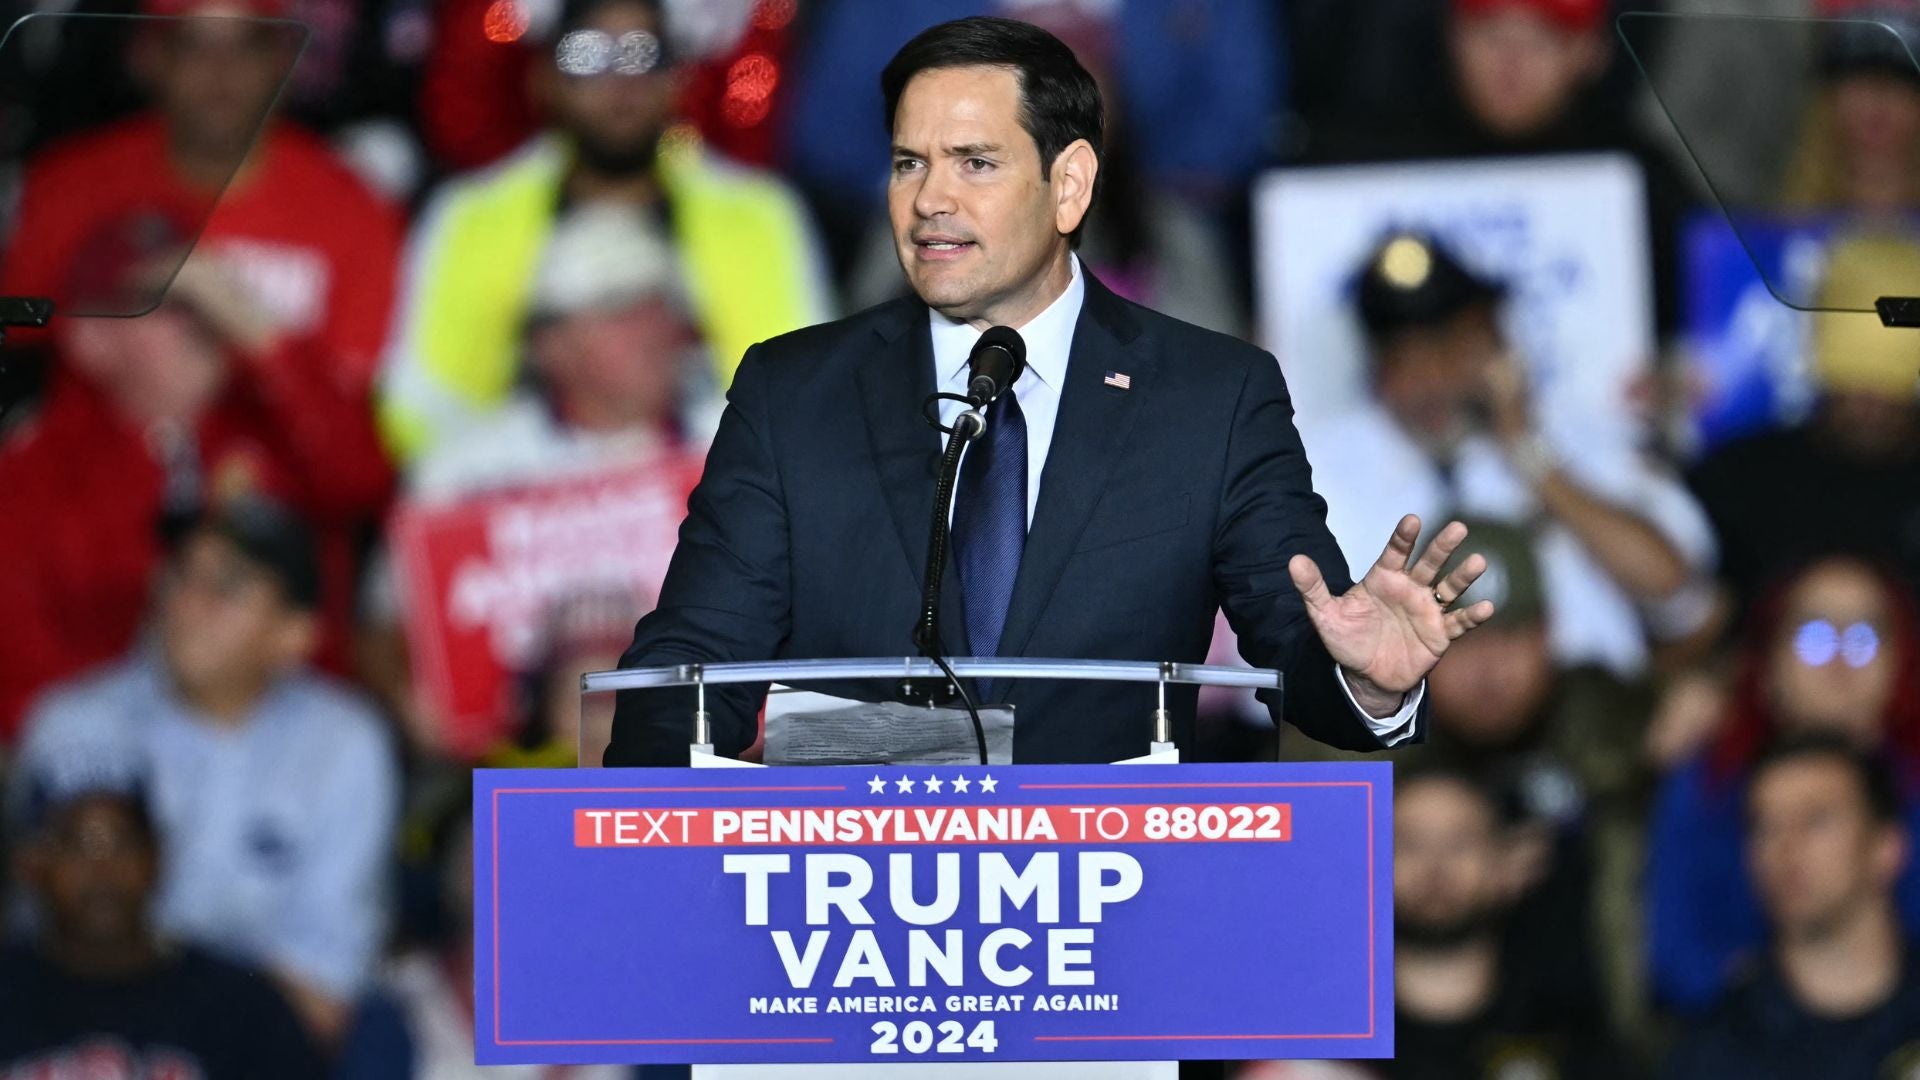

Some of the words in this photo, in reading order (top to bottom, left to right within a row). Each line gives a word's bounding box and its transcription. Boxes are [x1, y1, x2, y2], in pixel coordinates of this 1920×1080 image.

[584, 810, 699, 844] TEXT
[713, 808, 1058, 843] PENNSYLVANIA
[1070, 807, 1129, 841] TO
[1143, 806, 1281, 840] 88022
[723, 851, 1144, 925] TRUMP
[770, 928, 1095, 988] VANCE
[749, 996, 818, 1014] MAKE
[826, 996, 937, 1013] AMERICA
[945, 995, 1025, 1012] GREAT
[1033, 994, 1119, 1012] AGAIN!
[870, 1020, 998, 1054] 2024
